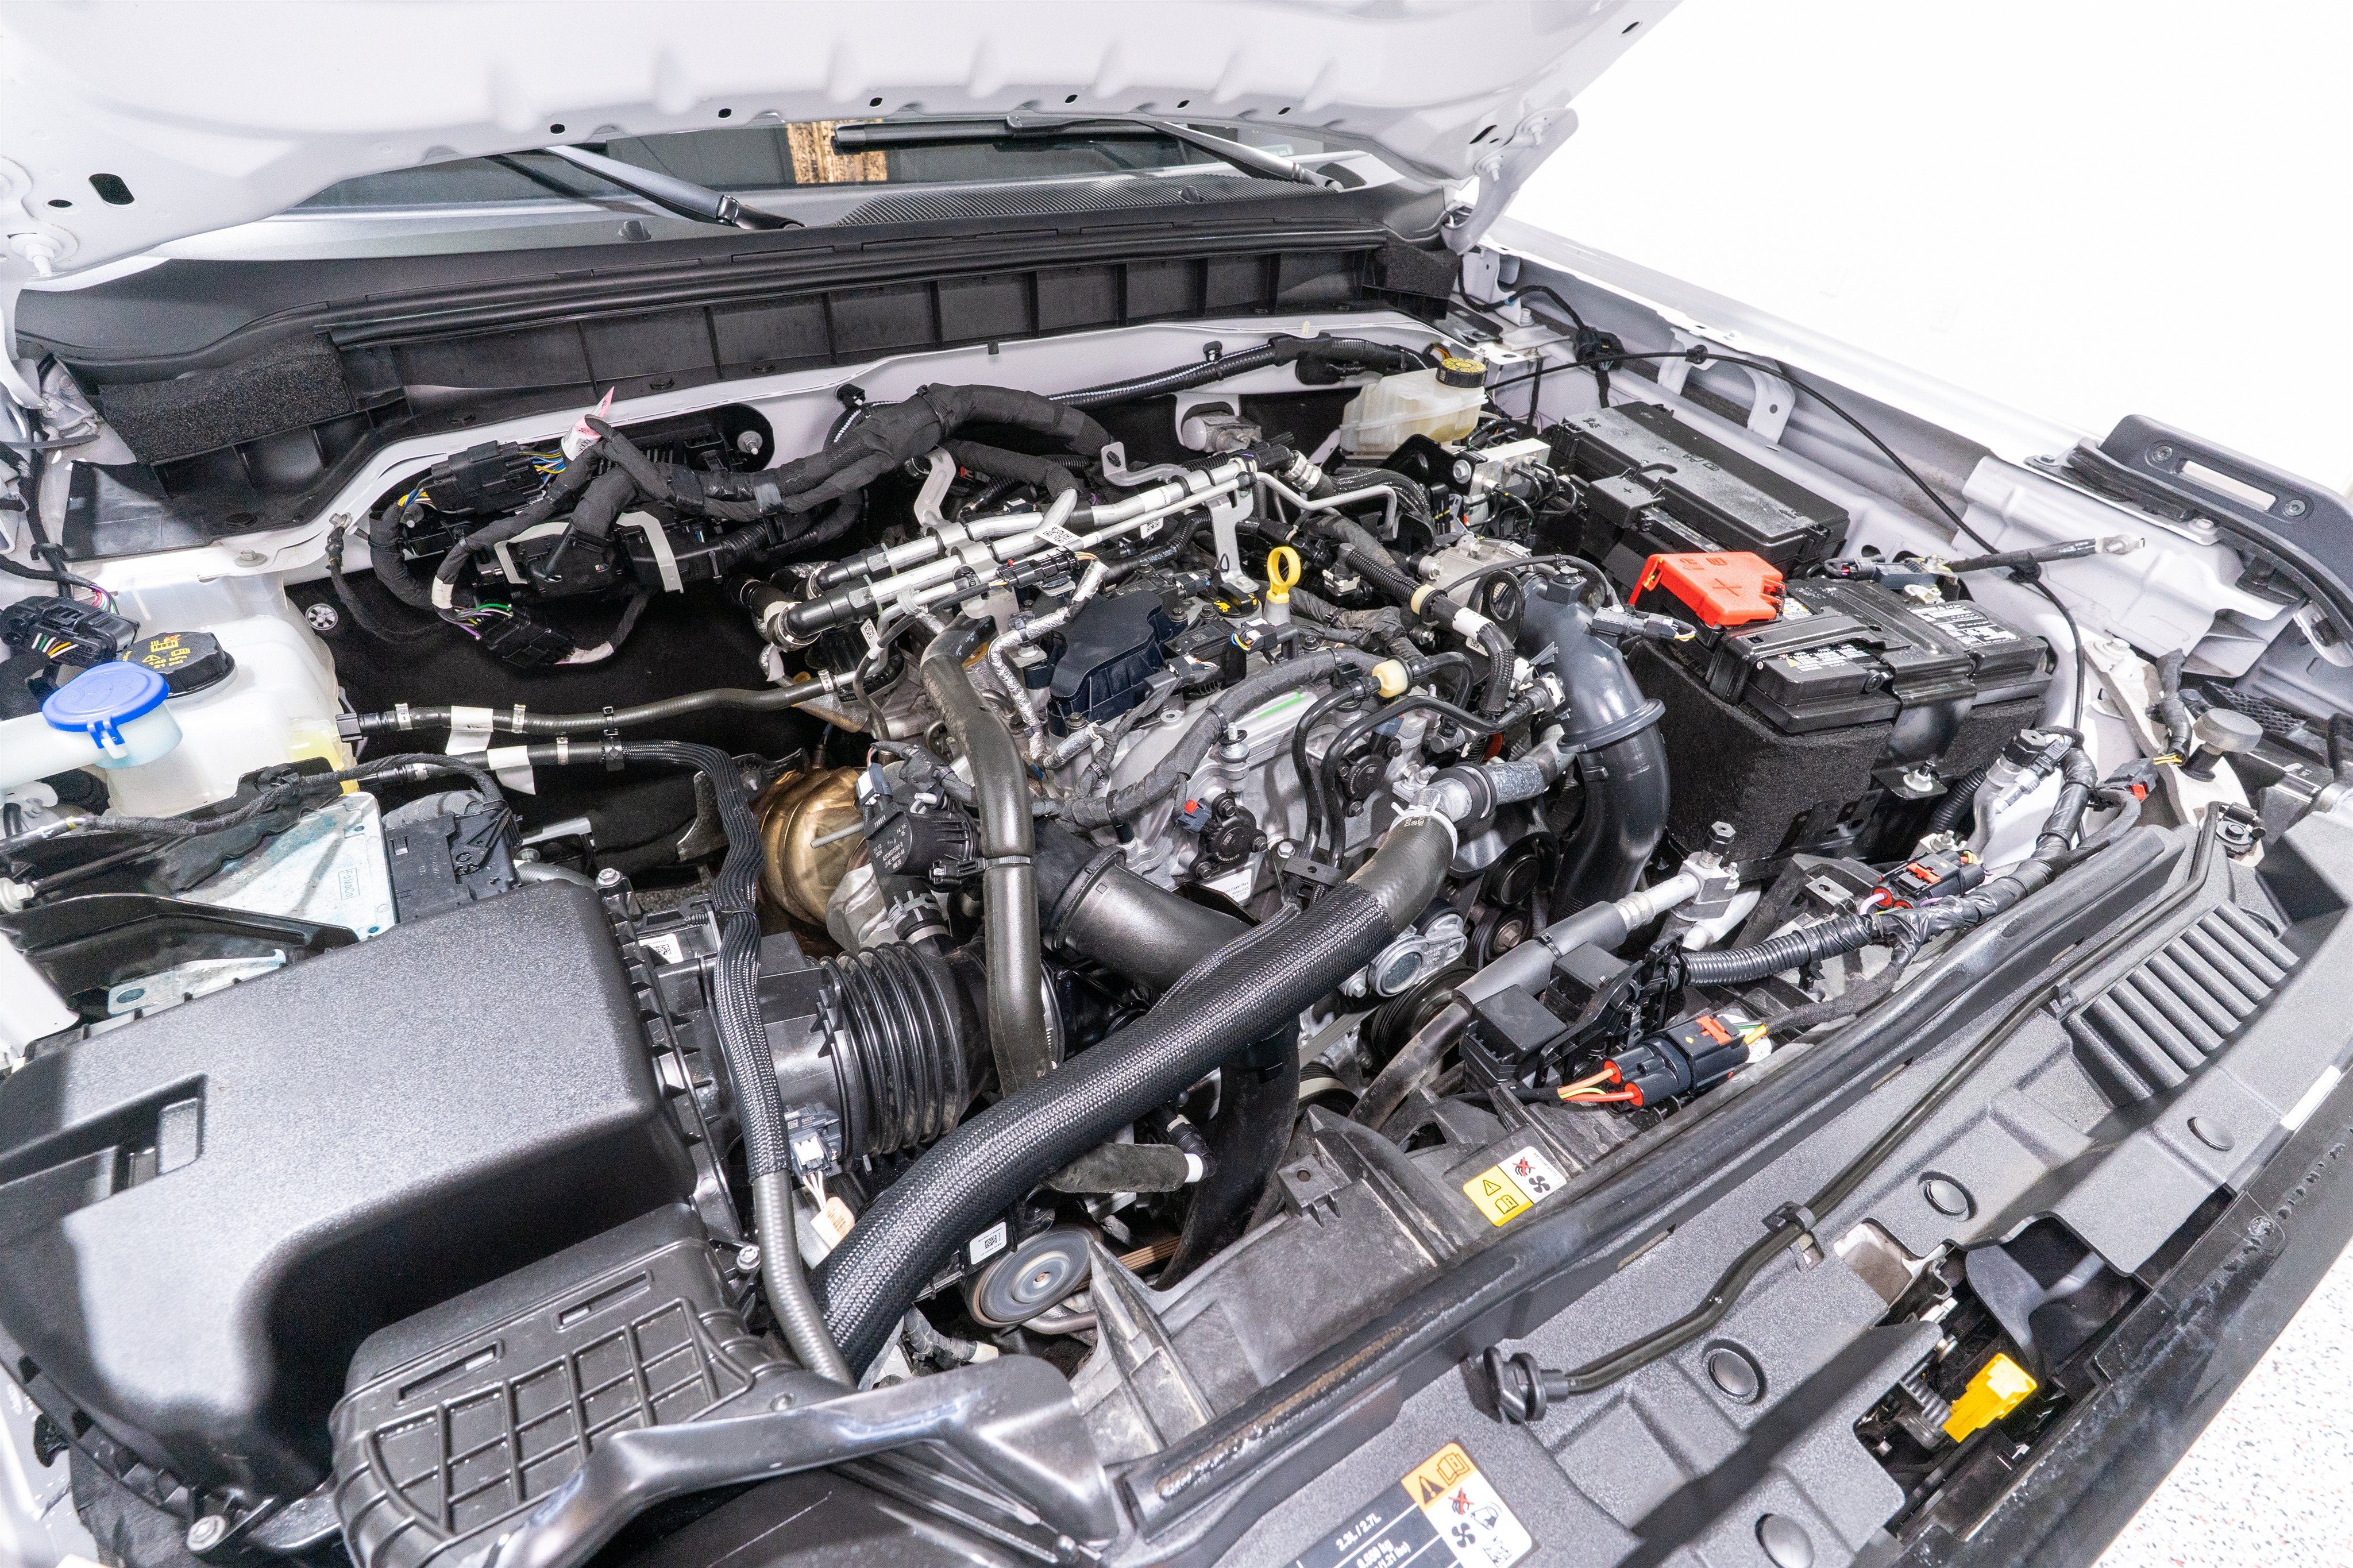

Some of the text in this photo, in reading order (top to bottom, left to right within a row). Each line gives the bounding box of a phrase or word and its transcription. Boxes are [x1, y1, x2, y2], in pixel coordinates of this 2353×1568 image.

[343, 871, 357, 898] FoMoCo
[1336, 1531, 1359, 1551] 2.3L
[1359, 1513, 1382, 1533] 2.7L
